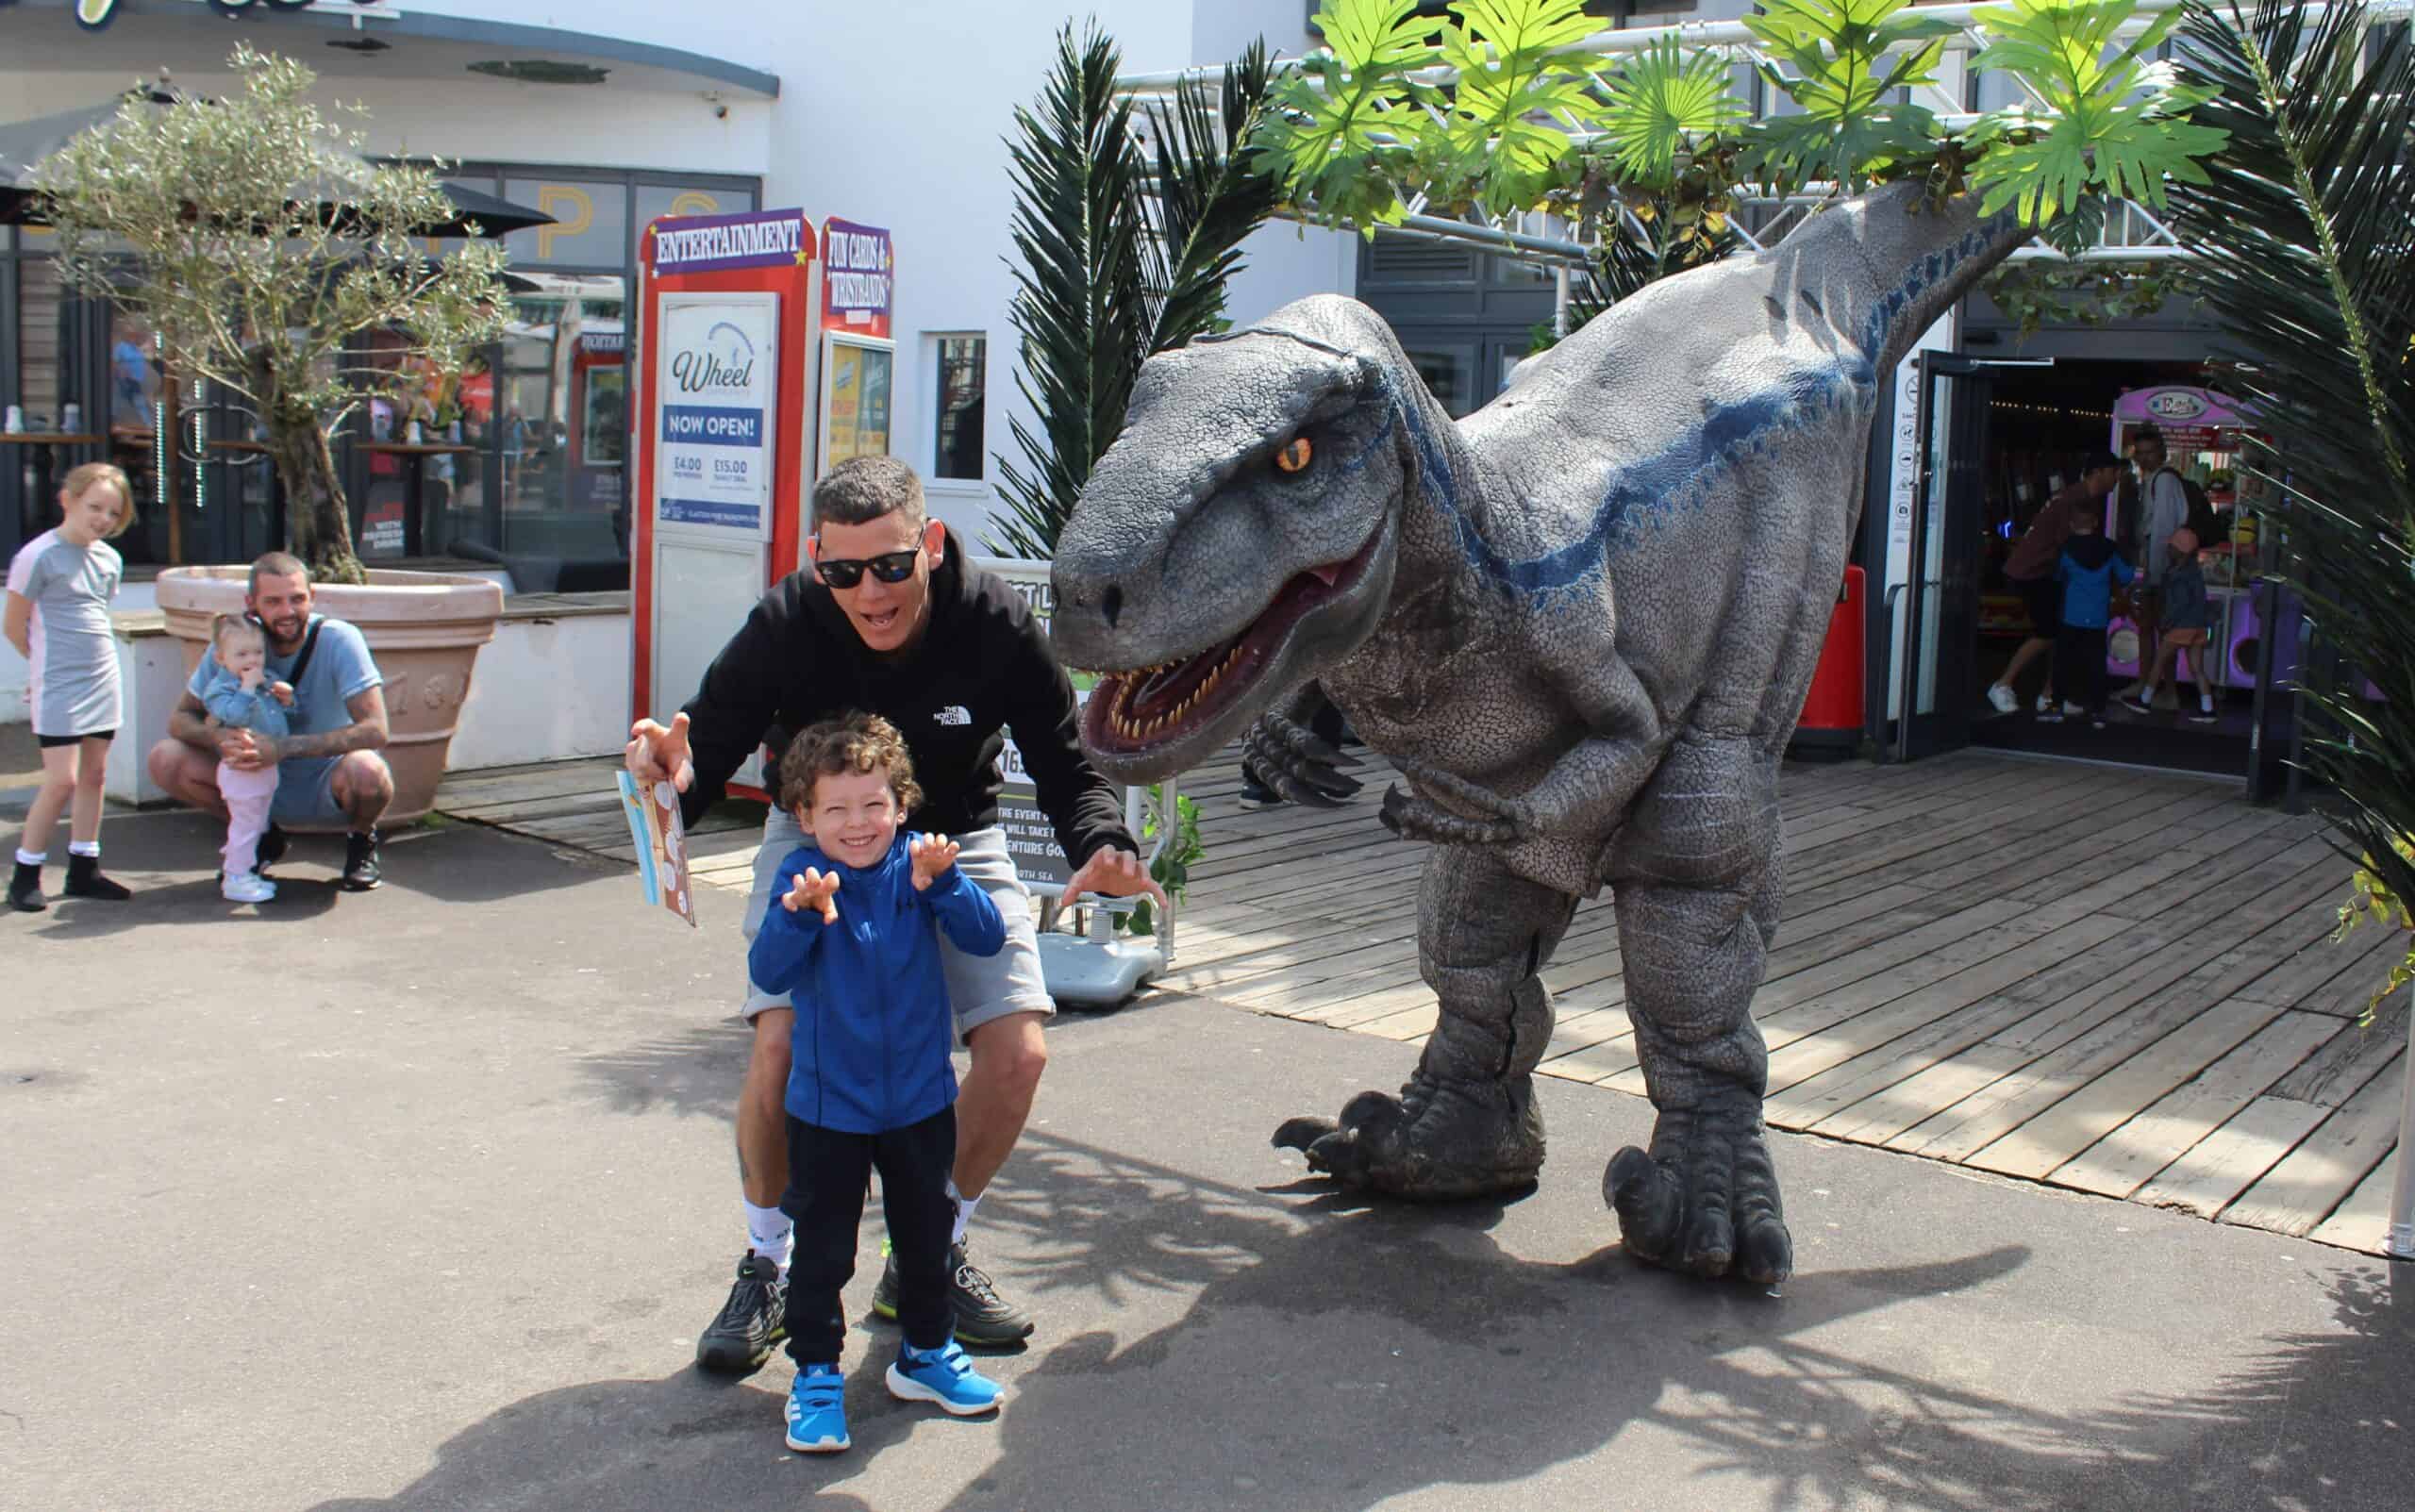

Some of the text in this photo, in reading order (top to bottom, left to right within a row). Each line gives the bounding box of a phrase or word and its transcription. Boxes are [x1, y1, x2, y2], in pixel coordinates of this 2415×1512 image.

[656, 219, 801, 264] ENTERTAINMENT
[828, 231, 848, 269] FUN
[849, 232, 878, 271] CARDS
[830, 271, 887, 309] WRISTBANDS
[673, 350, 754, 392] Wheel
[669, 415, 754, 437] NOW OPEN!
[674, 457, 748, 474] £4.00 £15.00
[1003, 749, 1026, 773] 16
[1014, 808, 1041, 822] EVENT
[1006, 823, 1026, 836] WILL
[1027, 825, 1050, 839] TAKE
[1006, 839, 1044, 856] ENTURE
